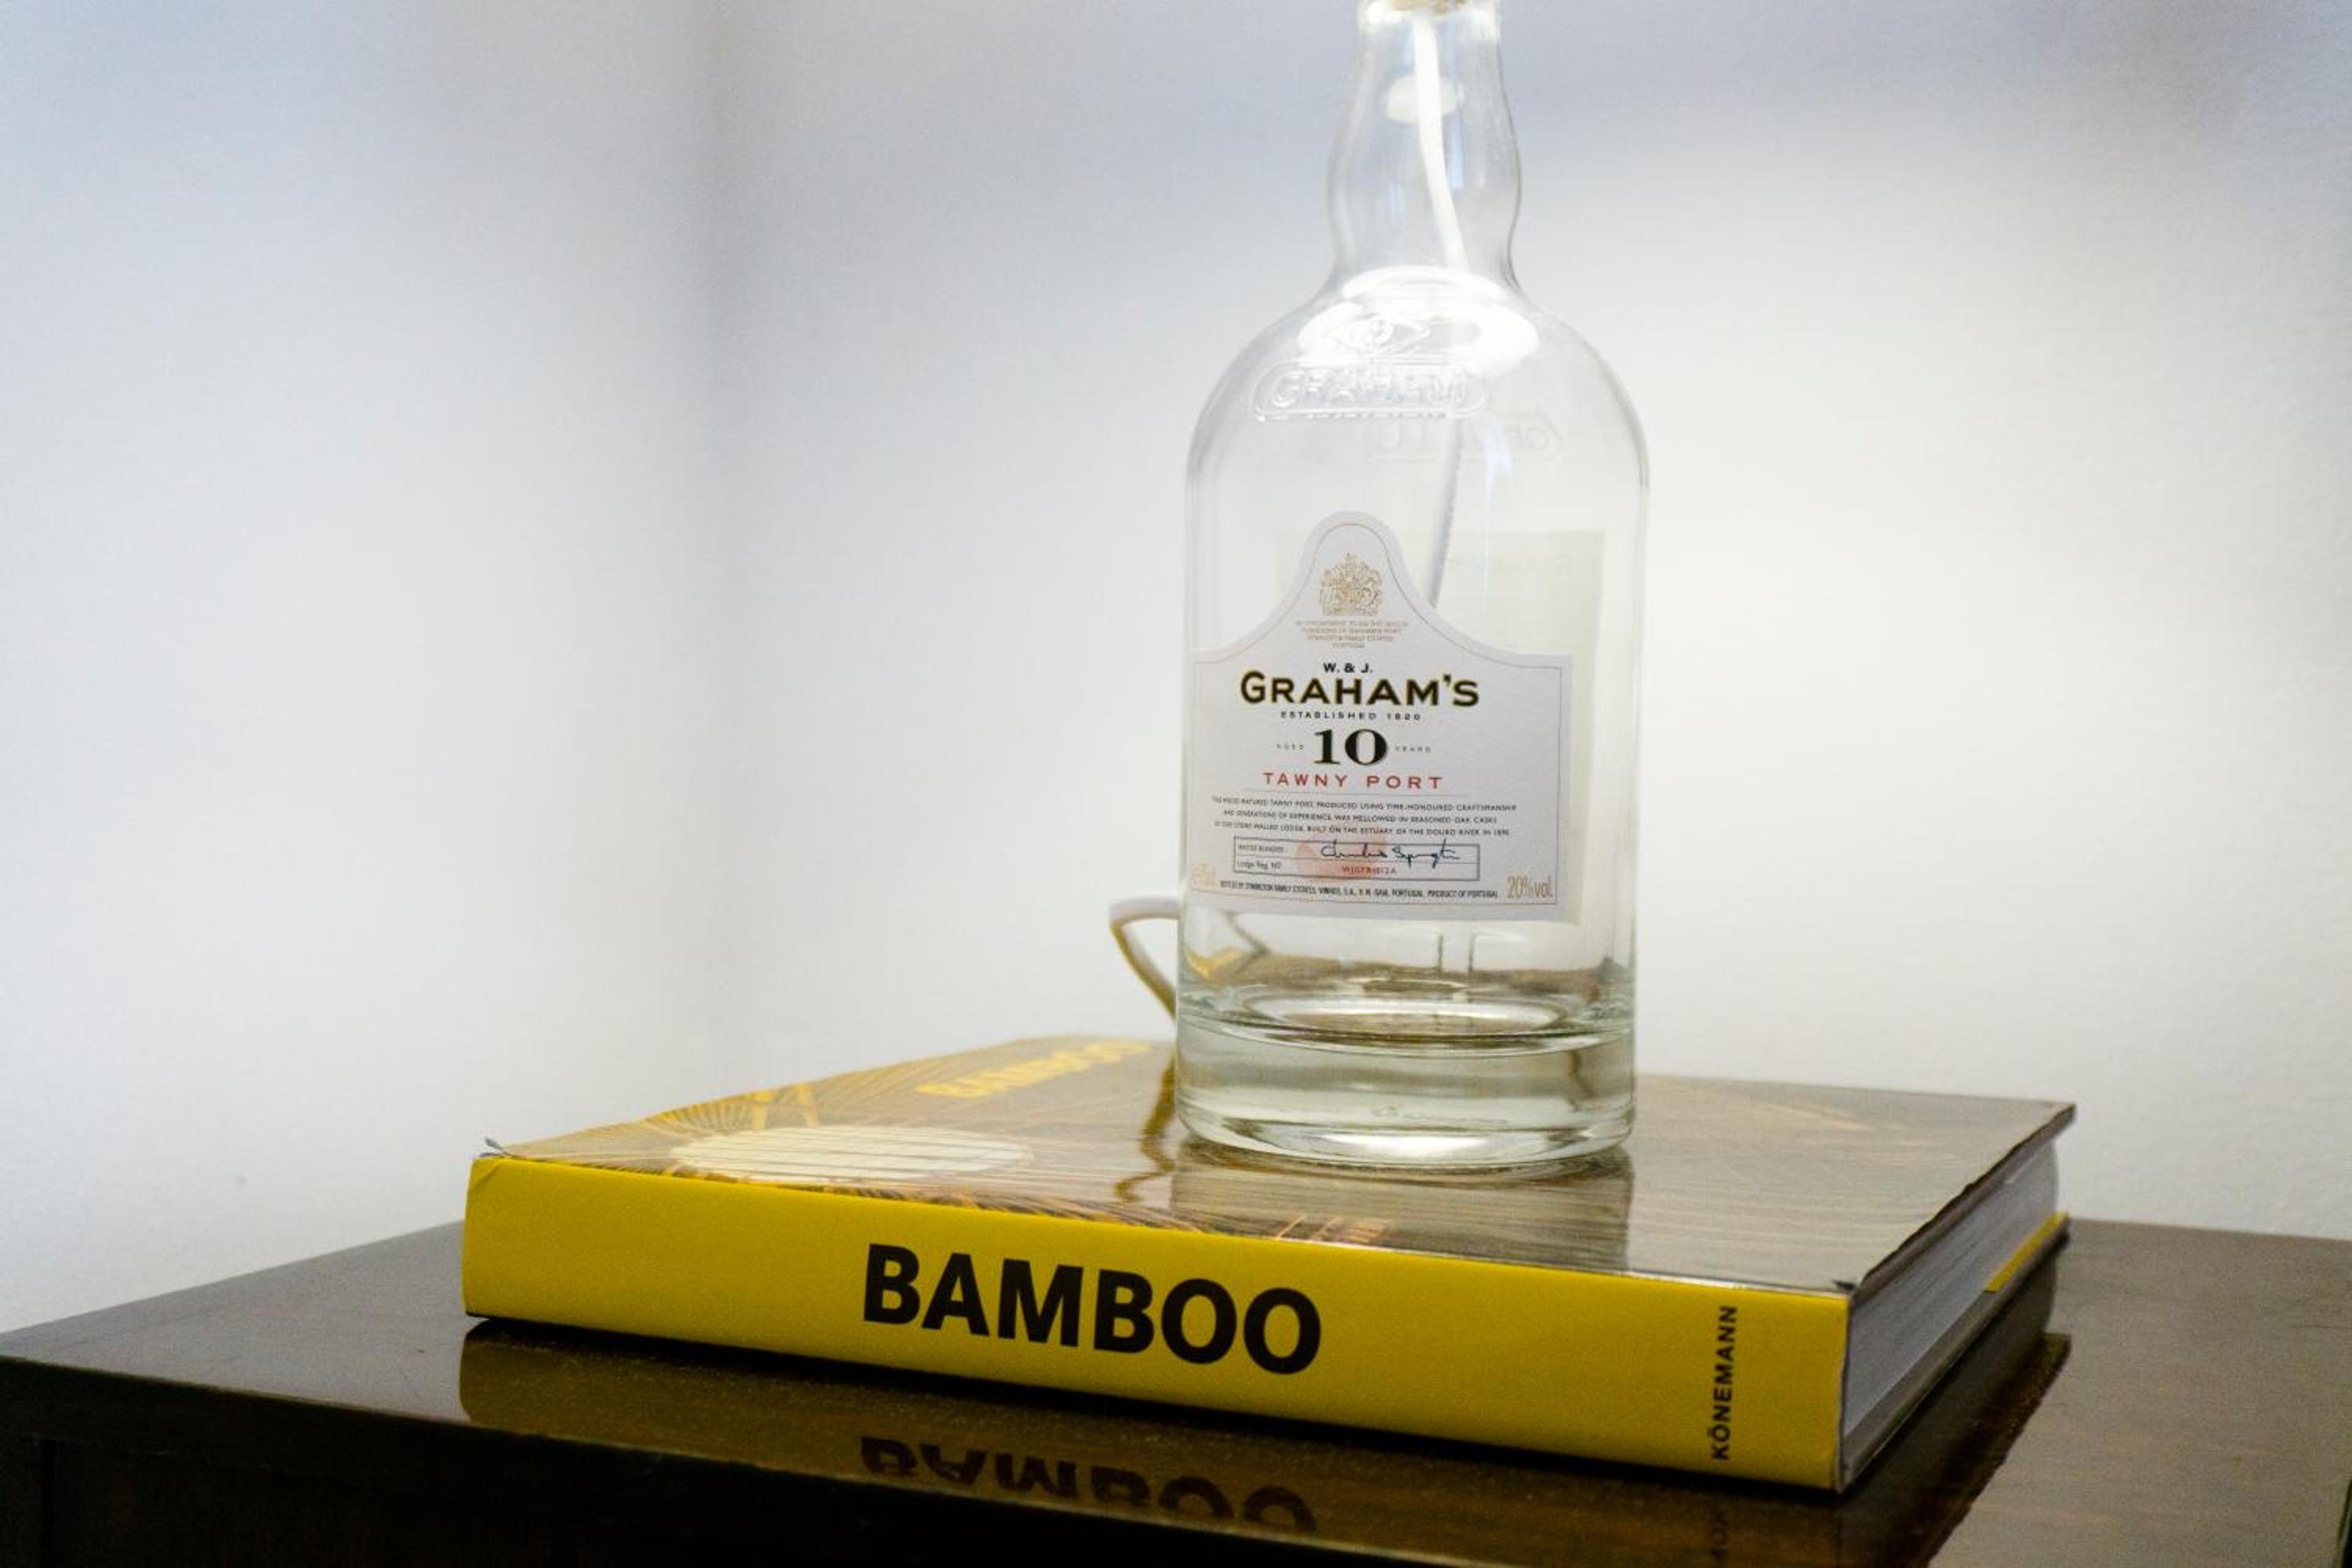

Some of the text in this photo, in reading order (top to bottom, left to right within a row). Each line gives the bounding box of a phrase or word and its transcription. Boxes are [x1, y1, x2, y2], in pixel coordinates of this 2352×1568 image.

[1323, 662, 1373, 673] W. & J.
[1240, 670, 1480, 707] GRAHAM'S
[1279, 710, 1421, 721] ESTABLISHED 1820
[1314, 728, 1388, 766] 10
[1262, 771, 1443, 789] TAWNY PORT
[1289, 812, 1332, 821] EXPERIENCE
[862, 1243, 1322, 1375] BAMBOO
[1707, 1305, 1738, 1461] KÖNEMANN
